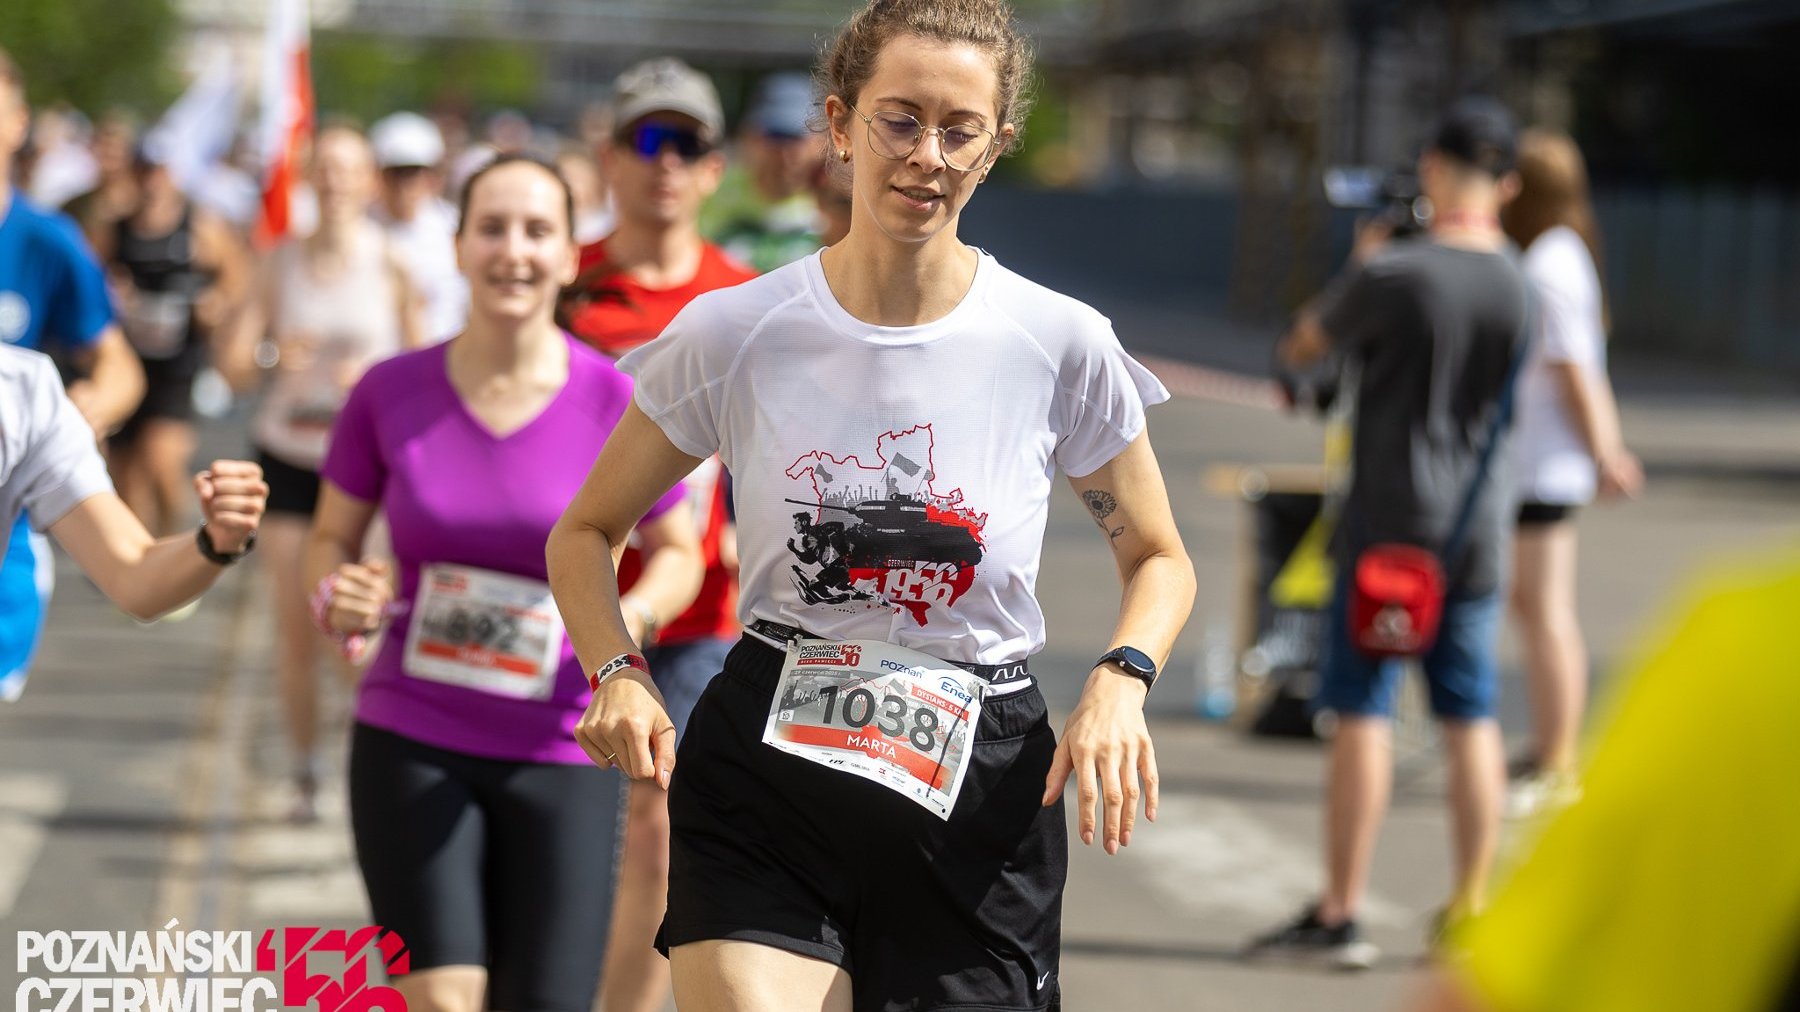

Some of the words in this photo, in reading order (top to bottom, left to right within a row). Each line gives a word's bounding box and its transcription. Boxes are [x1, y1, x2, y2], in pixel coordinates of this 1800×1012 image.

[887, 559, 915, 568] CZERWIEC
[882, 561, 959, 605] 1956
[800, 650, 840, 659] CZERWIEC
[801, 643, 837, 651] POZNAŃSKI
[916, 689, 947, 710] DYSTANS:
[940, 681, 974, 704] Enea
[819, 685, 939, 752] 1038
[846, 734, 897, 760] MARTA
